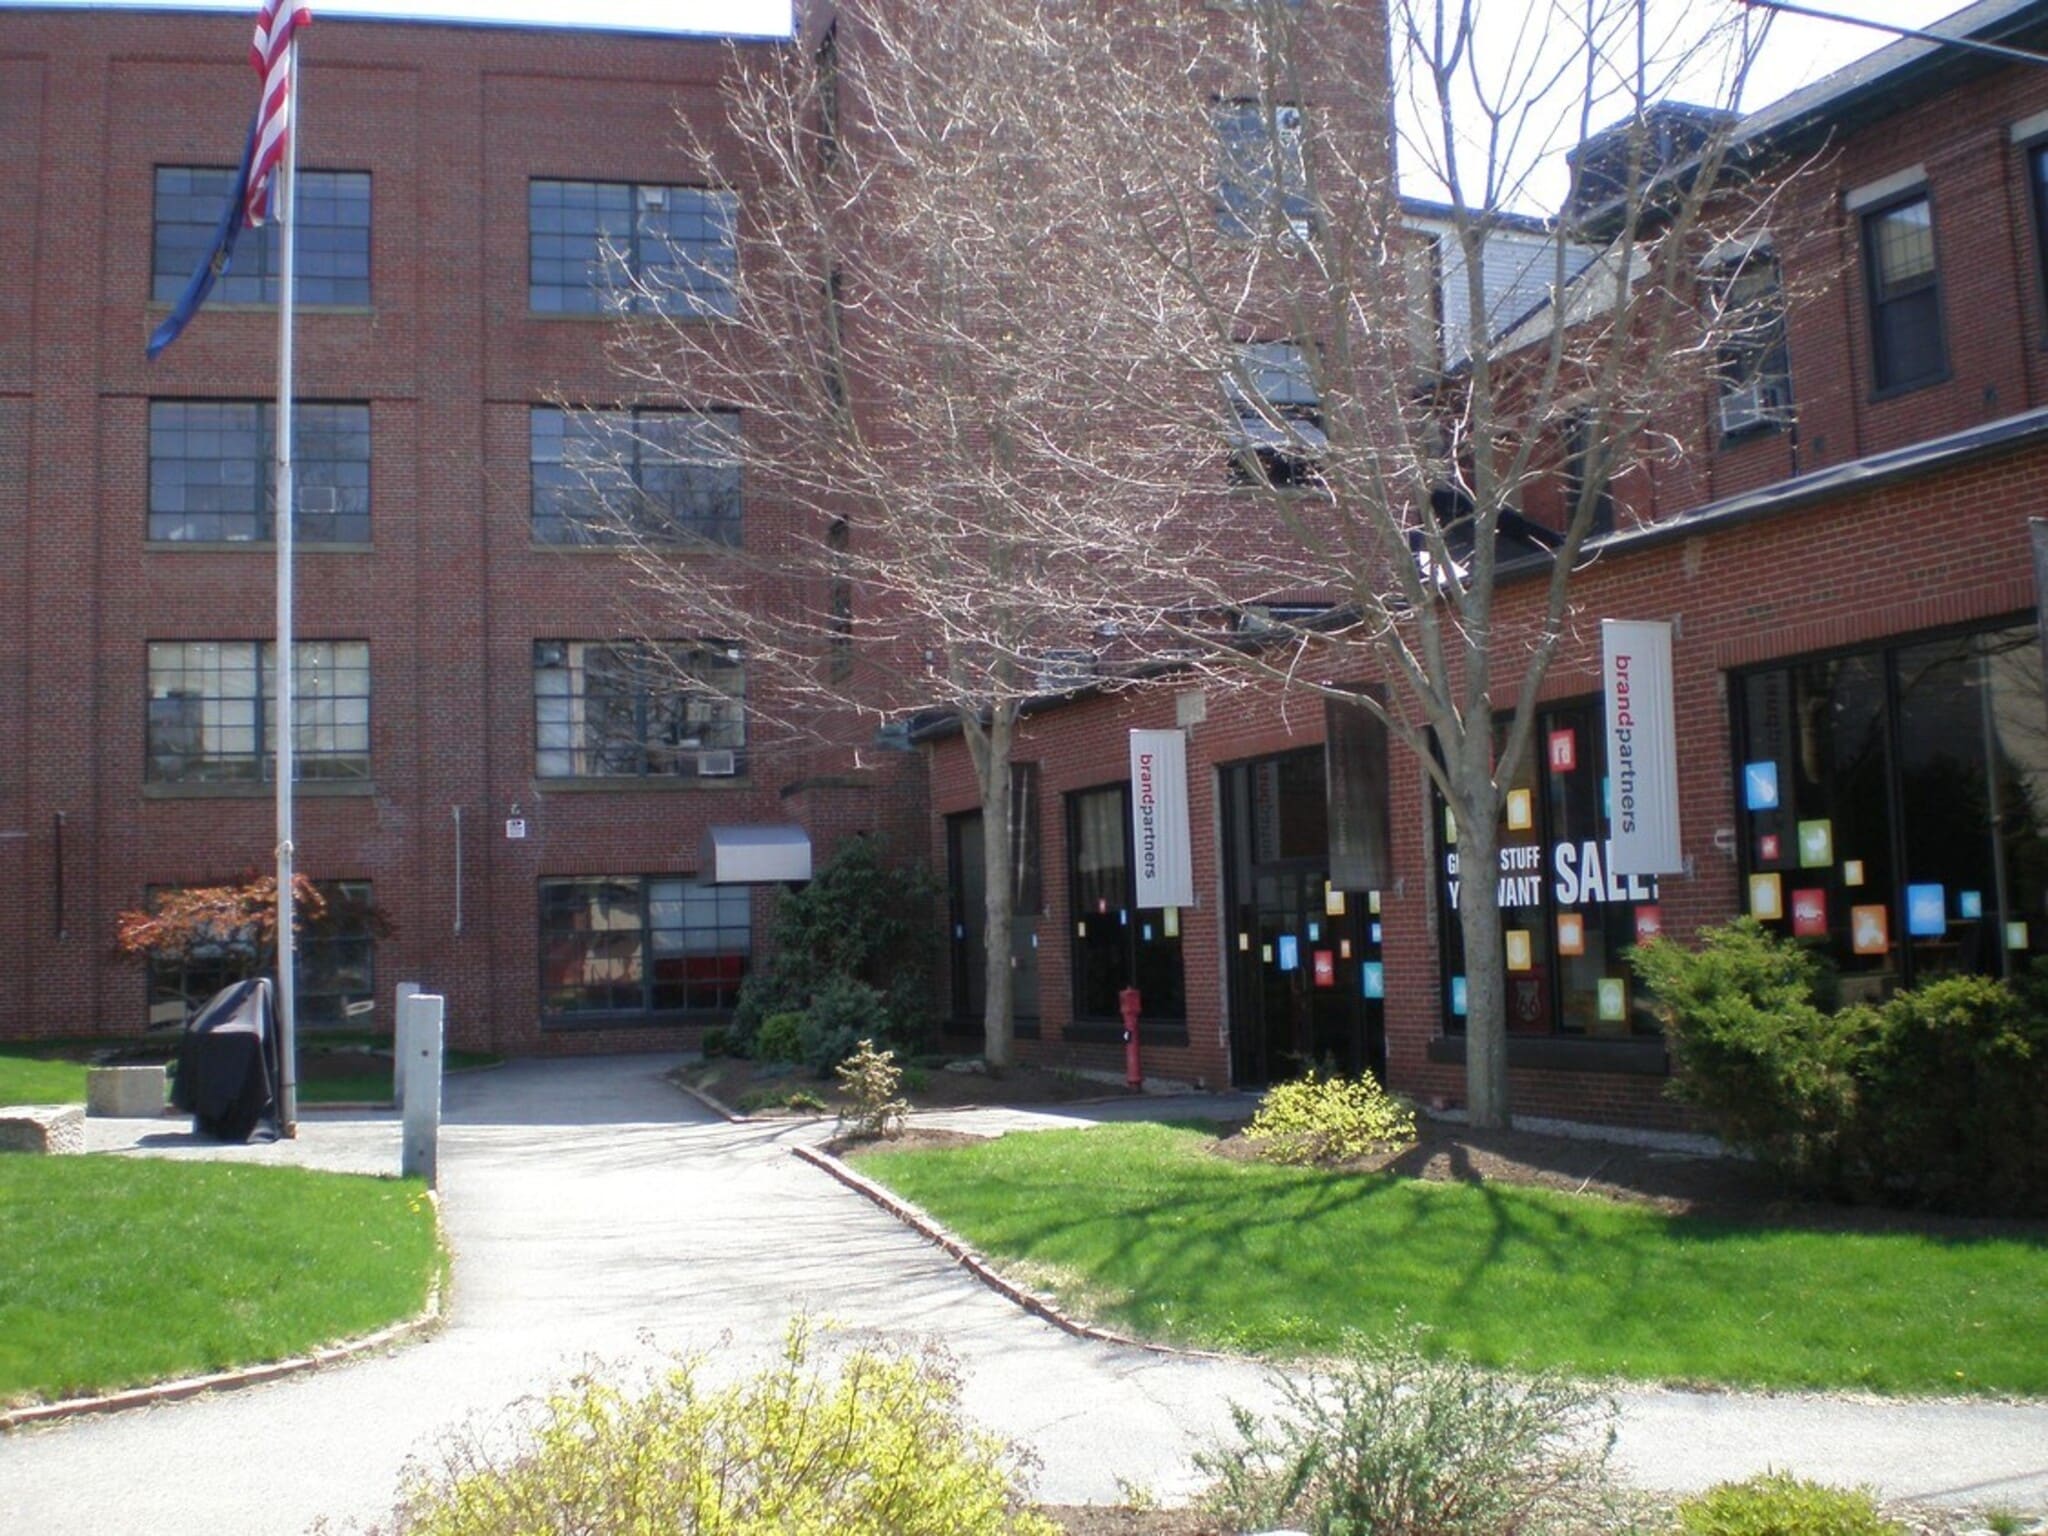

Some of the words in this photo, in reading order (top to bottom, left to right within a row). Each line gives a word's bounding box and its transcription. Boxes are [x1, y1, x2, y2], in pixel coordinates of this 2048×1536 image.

[1615, 655, 1636, 835] brandpartners
[1139, 753, 1156, 880] brandpartners
[1500, 845, 1542, 871] STUFF
